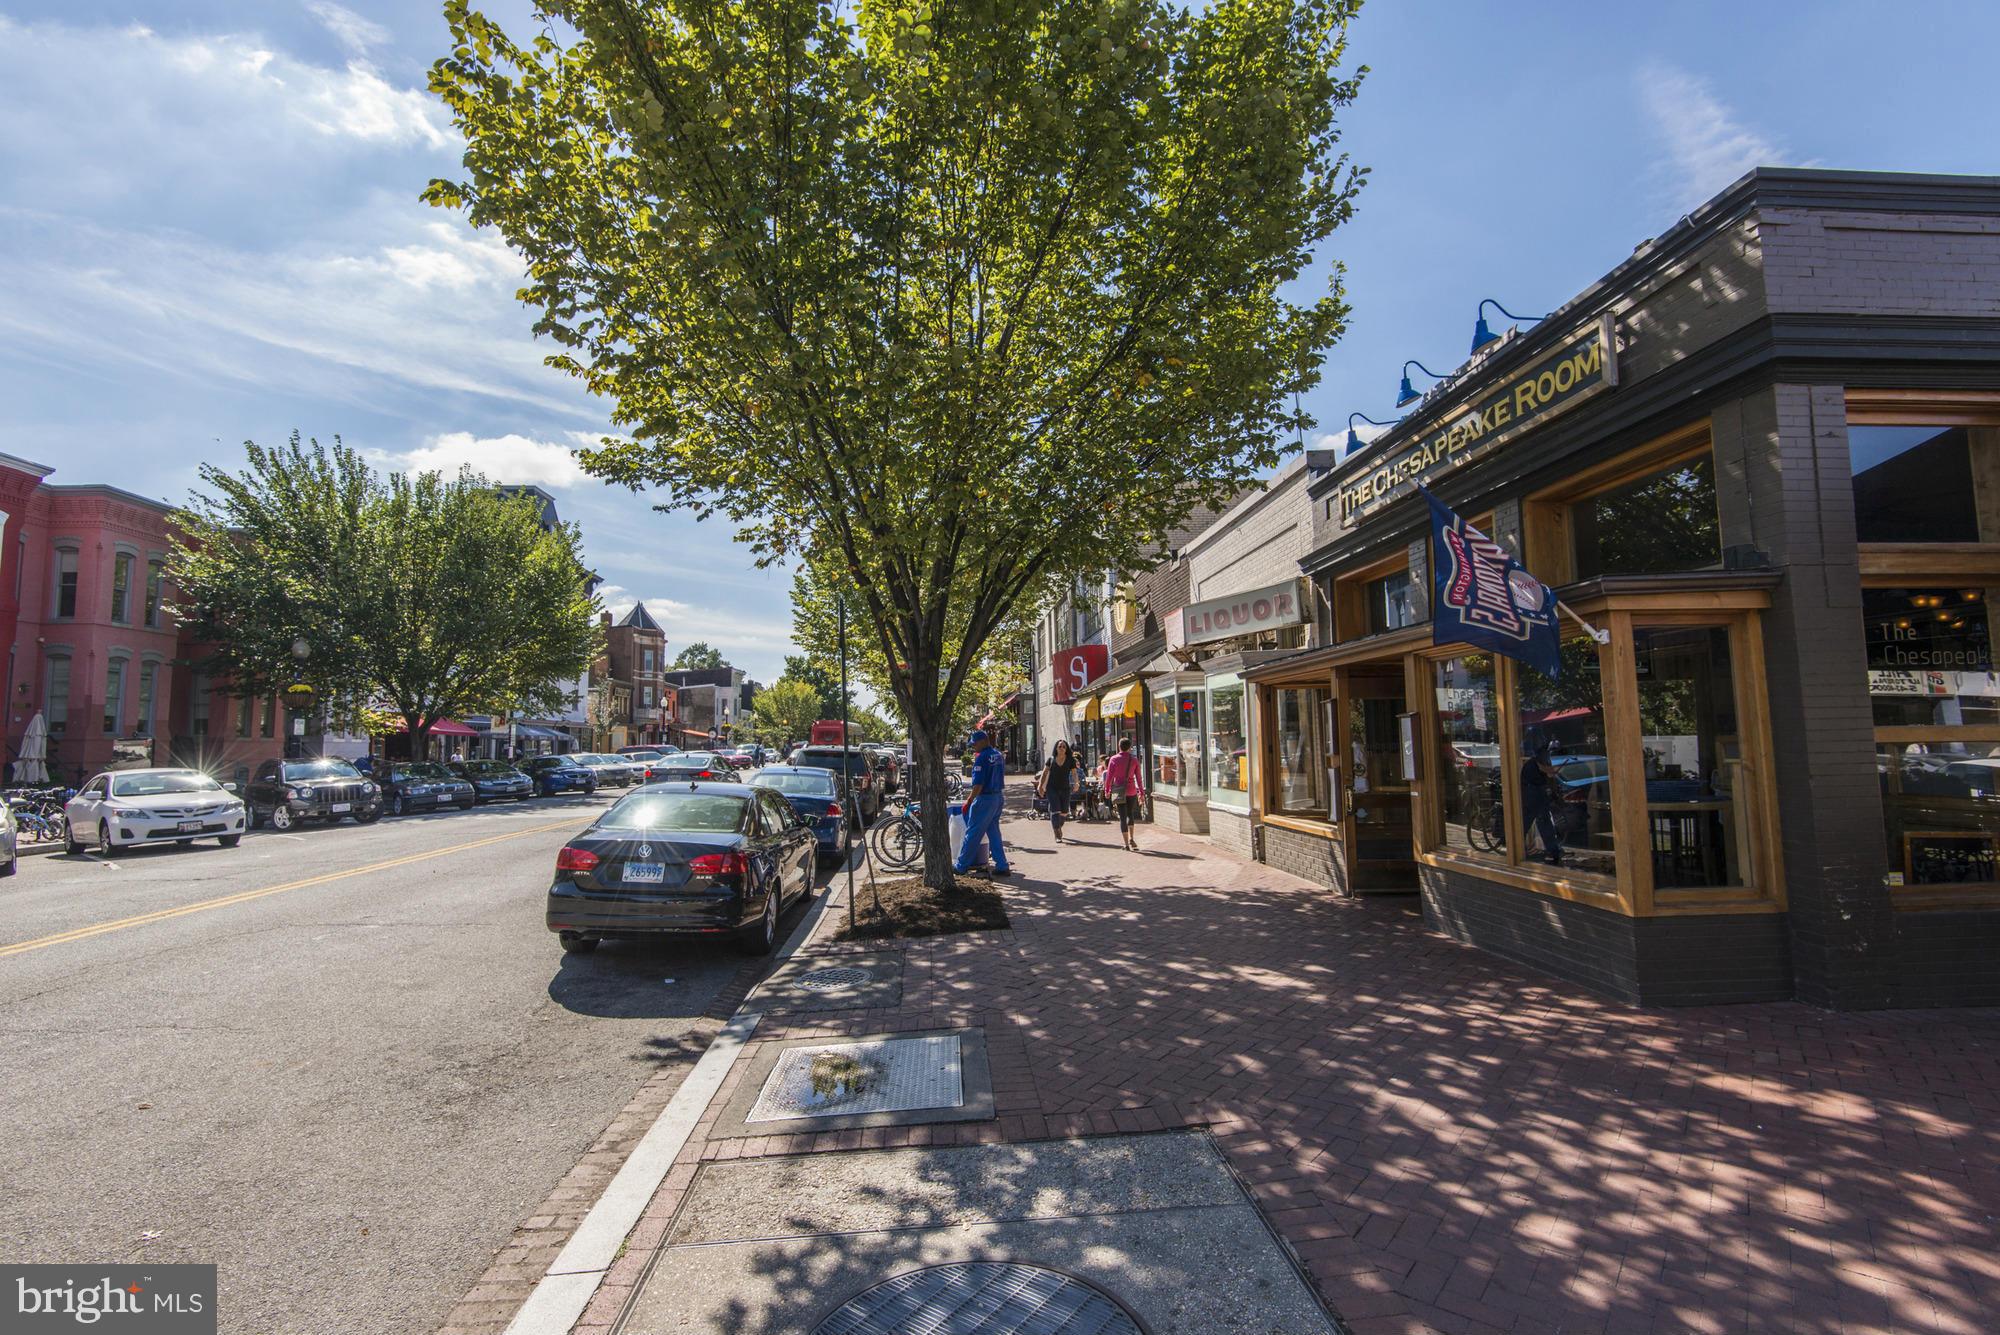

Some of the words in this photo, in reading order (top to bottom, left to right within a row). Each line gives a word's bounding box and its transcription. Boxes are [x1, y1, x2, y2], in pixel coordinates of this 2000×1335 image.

[1342, 480, 1372, 514] THE
[1373, 395, 1511, 496] CHESAPEAKE
[1515, 341, 1600, 417] ROOM
[1190, 593, 1293, 634] LIQUOR
[1880, 622, 1917, 641] The
